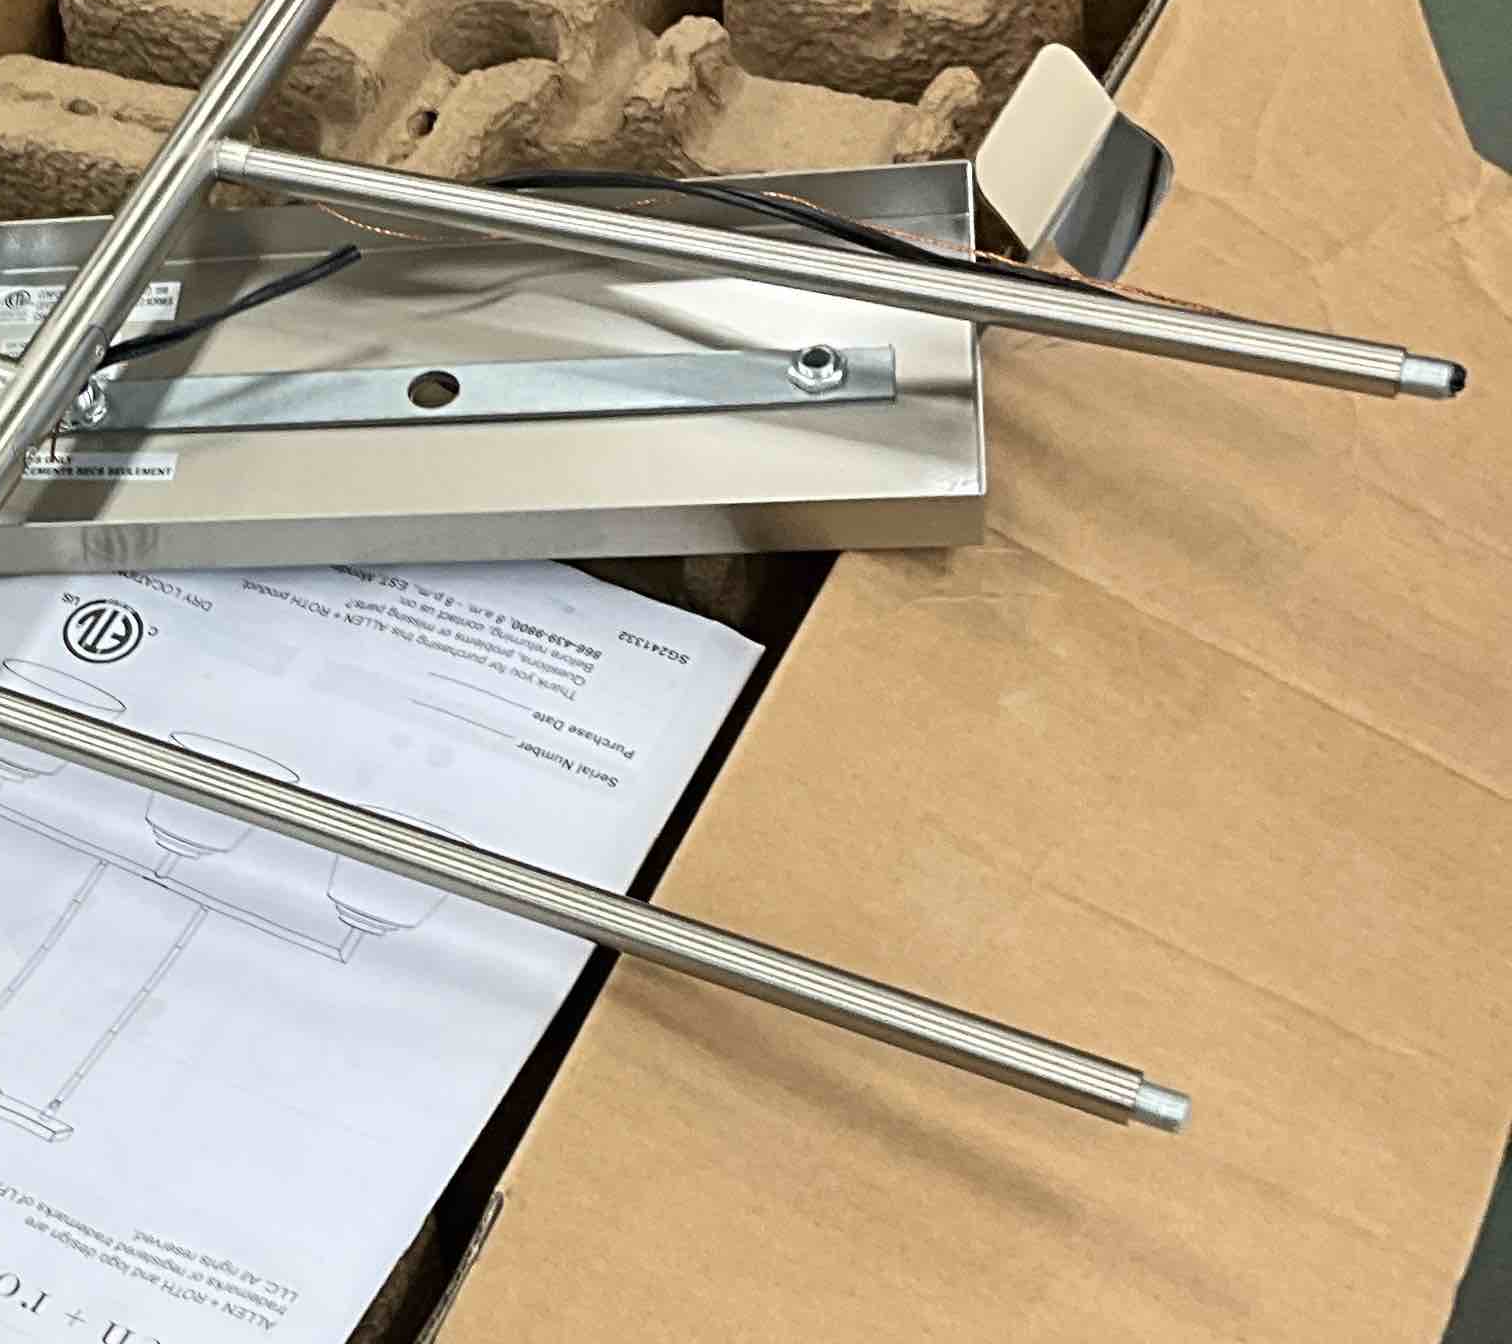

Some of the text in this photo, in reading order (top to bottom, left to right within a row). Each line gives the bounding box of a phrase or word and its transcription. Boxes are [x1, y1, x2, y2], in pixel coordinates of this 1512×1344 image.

[289, 594, 331, 618] ROTH
[343, 612, 388, 632] ALLEN
[531, 711, 636, 760] Purchase Date
[516, 741, 619, 788] Serial Number
[160, 1279, 208, 1305] ROTH
[63, 1308, 86, 1328] +
[221, 1301, 277, 1331] ALLEN
